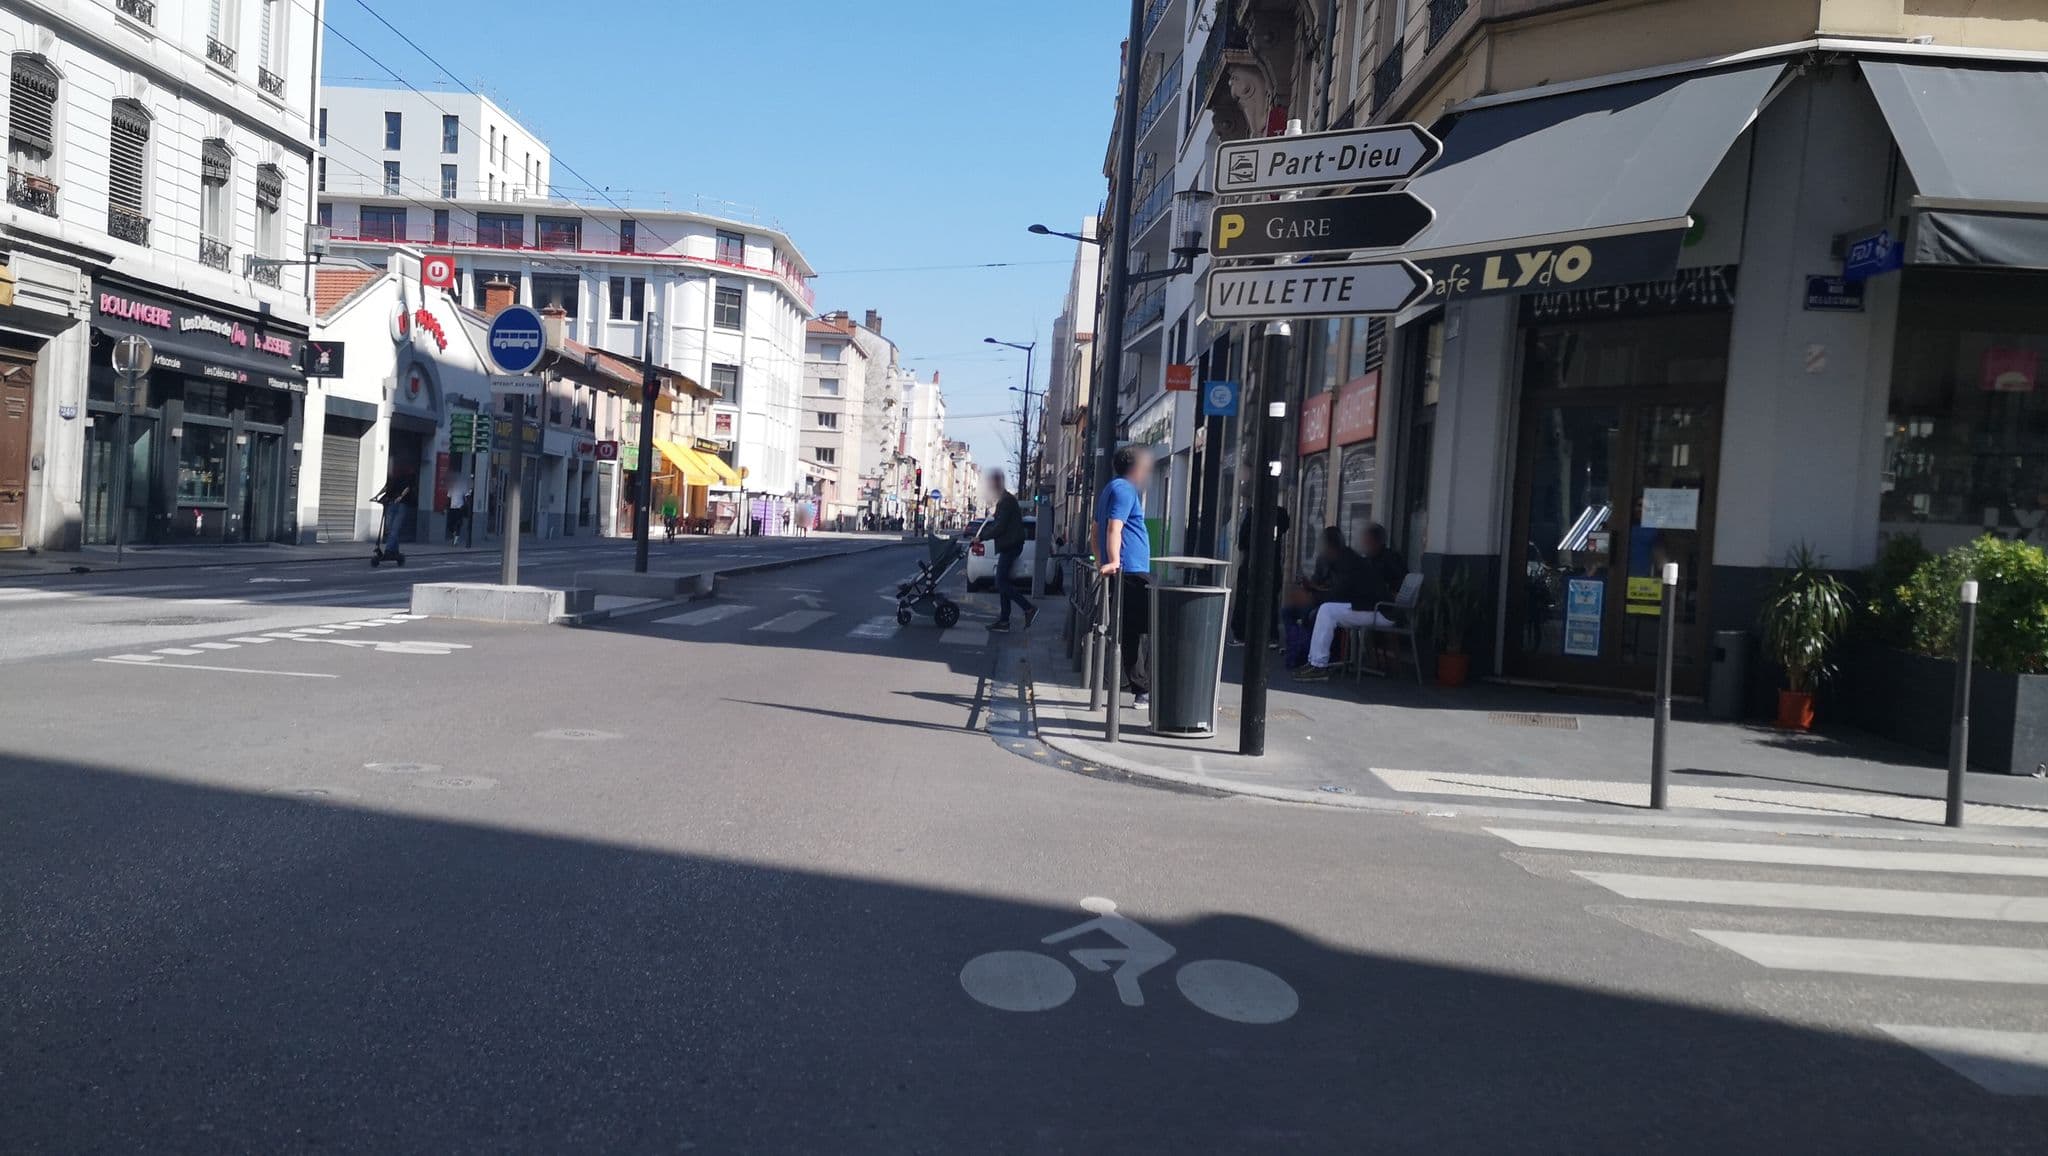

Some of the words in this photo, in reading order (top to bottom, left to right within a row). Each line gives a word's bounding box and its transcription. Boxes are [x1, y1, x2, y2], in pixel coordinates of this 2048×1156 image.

[1268, 143, 1402, 177] Part-Dieu
[1218, 214, 1246, 249] P
[1265, 217, 1332, 240] GARE
[1219, 276, 1355, 305] VILLETTE
[100, 293, 172, 329] BOULANGERIE
